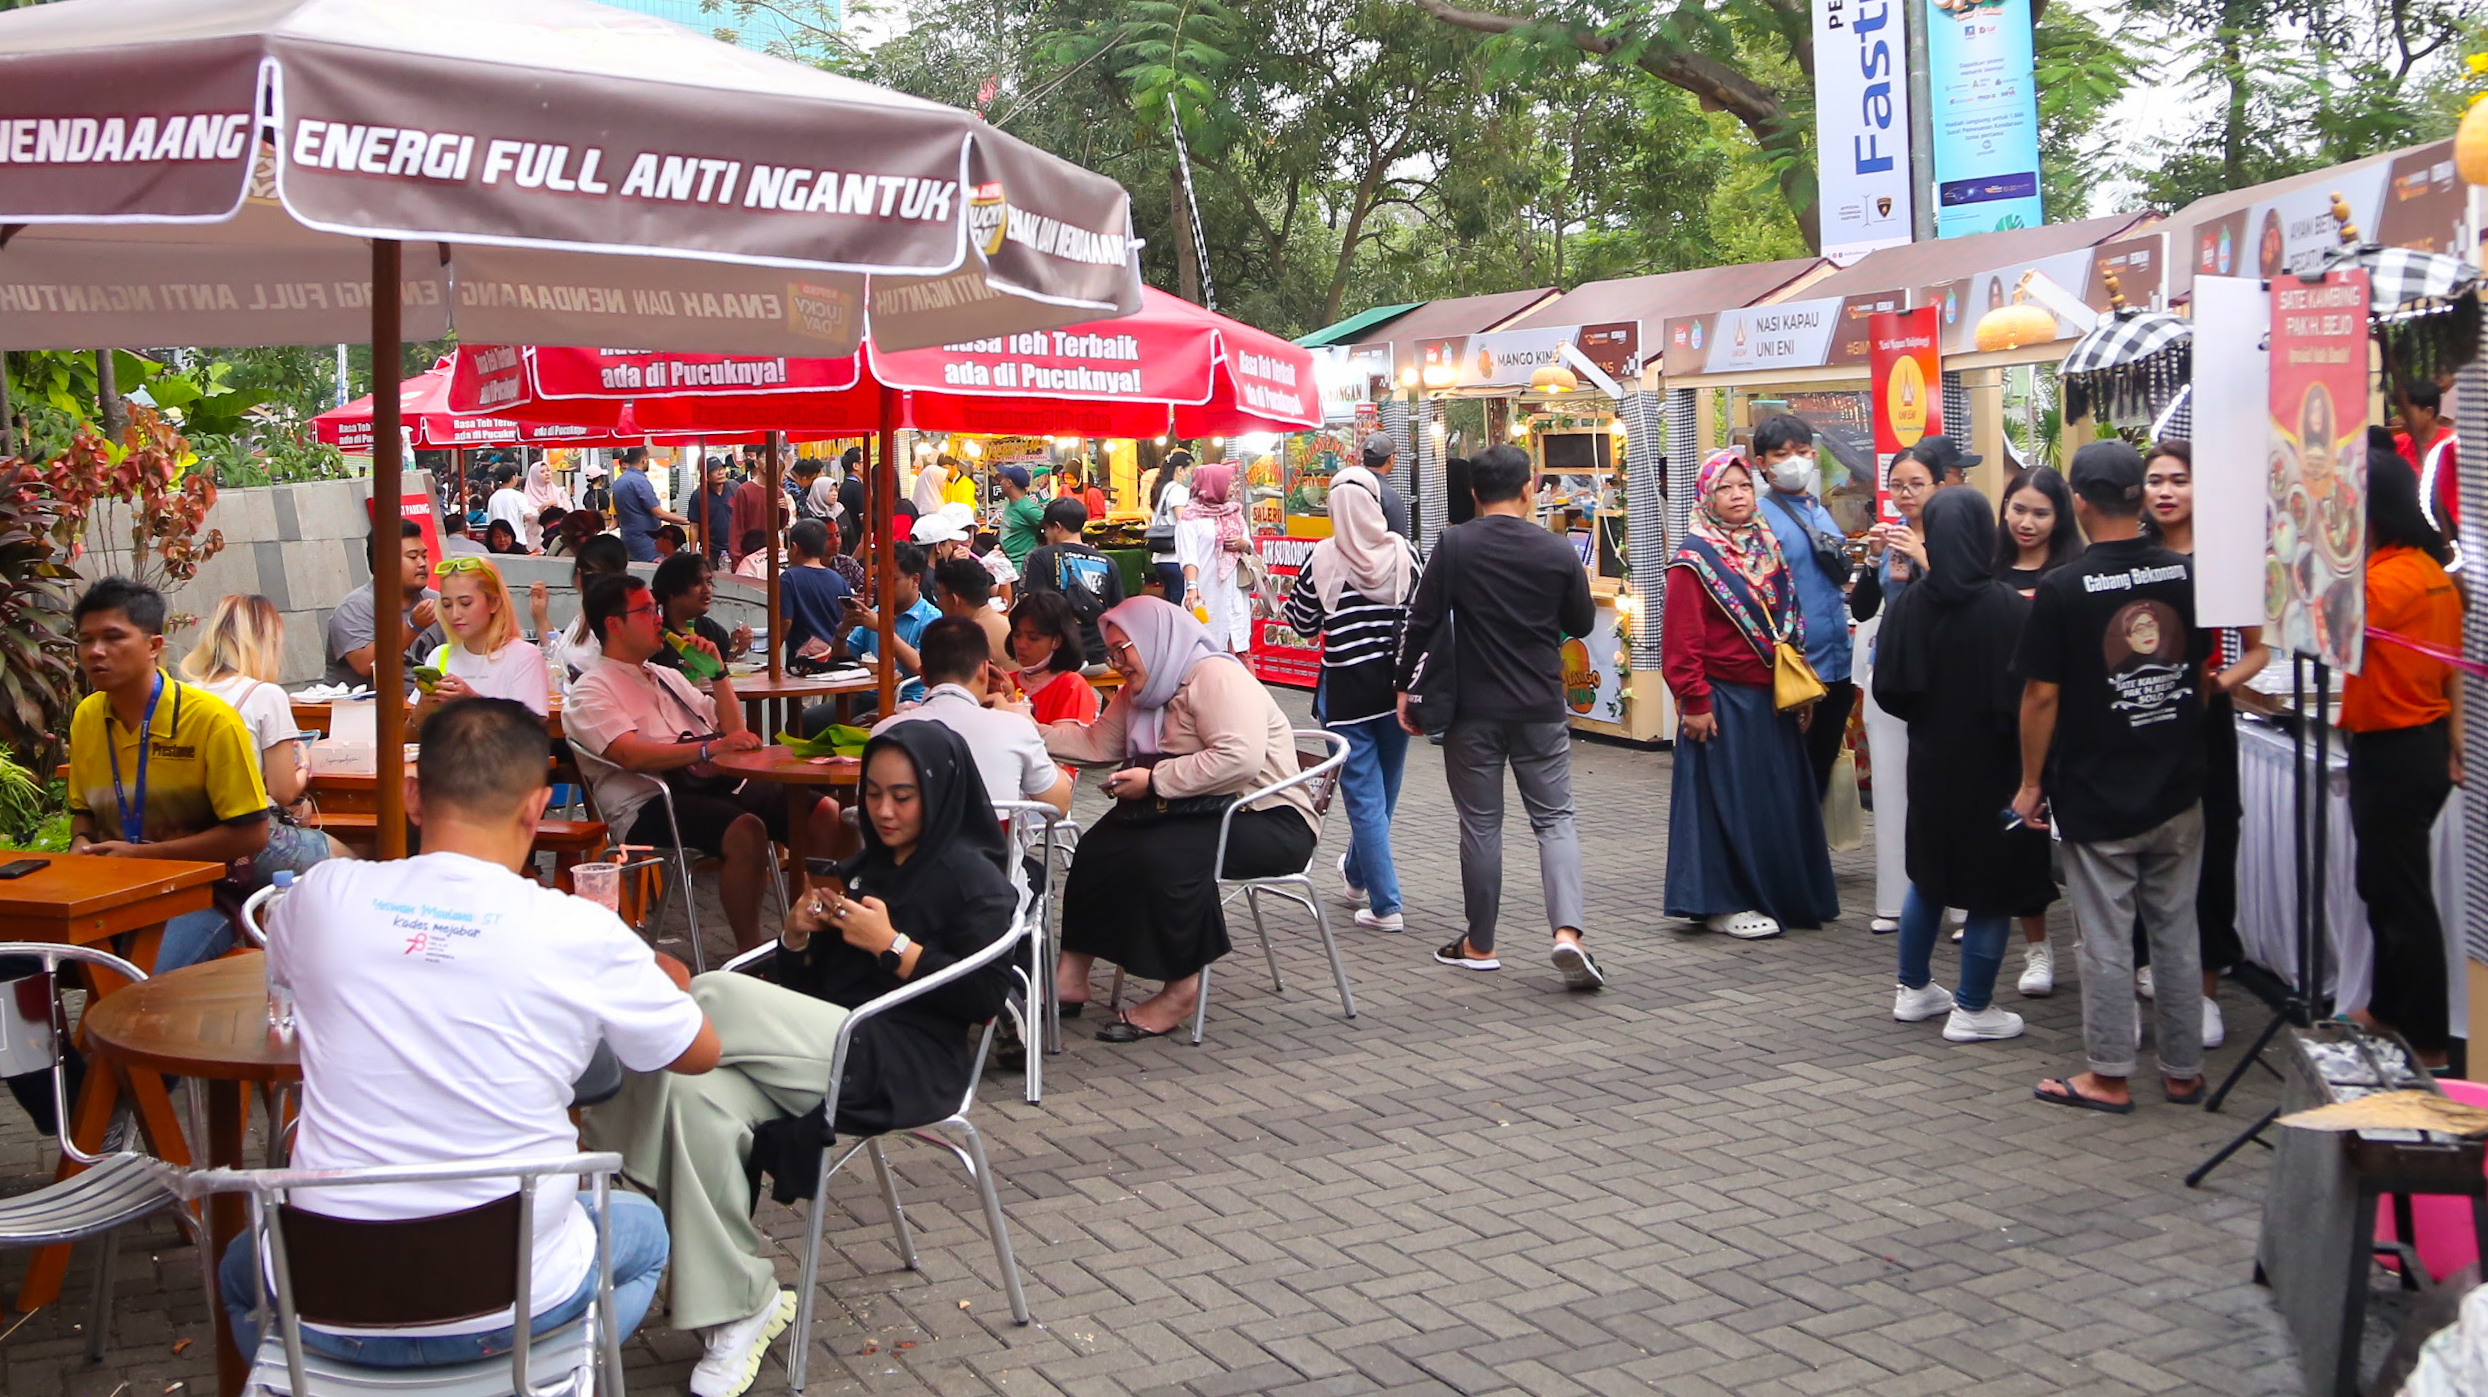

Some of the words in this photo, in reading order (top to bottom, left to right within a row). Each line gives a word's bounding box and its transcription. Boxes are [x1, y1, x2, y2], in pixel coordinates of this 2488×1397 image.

[1853, 0, 1894, 175] Fast
[292, 118, 476, 181] ENERGI
[482, 139, 609, 195] FULL
[620, 152, 742, 206] ANTI
[743, 164, 957, 222] NGANTUK
[1756, 316, 1781, 333] NASI
[1783, 311, 1819, 331] KAPAU
[1052, 330, 1140, 361] Terbaik
[1756, 342, 1775, 358] UNI
[1777, 340, 1795, 356] ENI
[1497, 351, 1533, 367] MANGO
[600, 364, 641, 390] ada
[645, 361, 667, 388] di
[670, 357, 786, 387] Pucuknya!
[944, 360, 990, 387] ada
[992, 361, 1017, 388] di
[1021, 361, 1142, 394] Pucuknya!
[453, 420, 475, 429] Rasa
[405, 503, 430, 515] PARKING
[1253, 507, 1283, 523] SALERO
[2082, 572, 2133, 592] Cabang
[2129, 564, 2187, 585] Bekonang
[1566, 669, 1601, 689] ANGO
[2115, 680, 2137, 692] SATE
[2123, 687, 2143, 699] PAK
[2138, 692, 2165, 705] SOLO
[152, 742, 195, 758] Prestone
